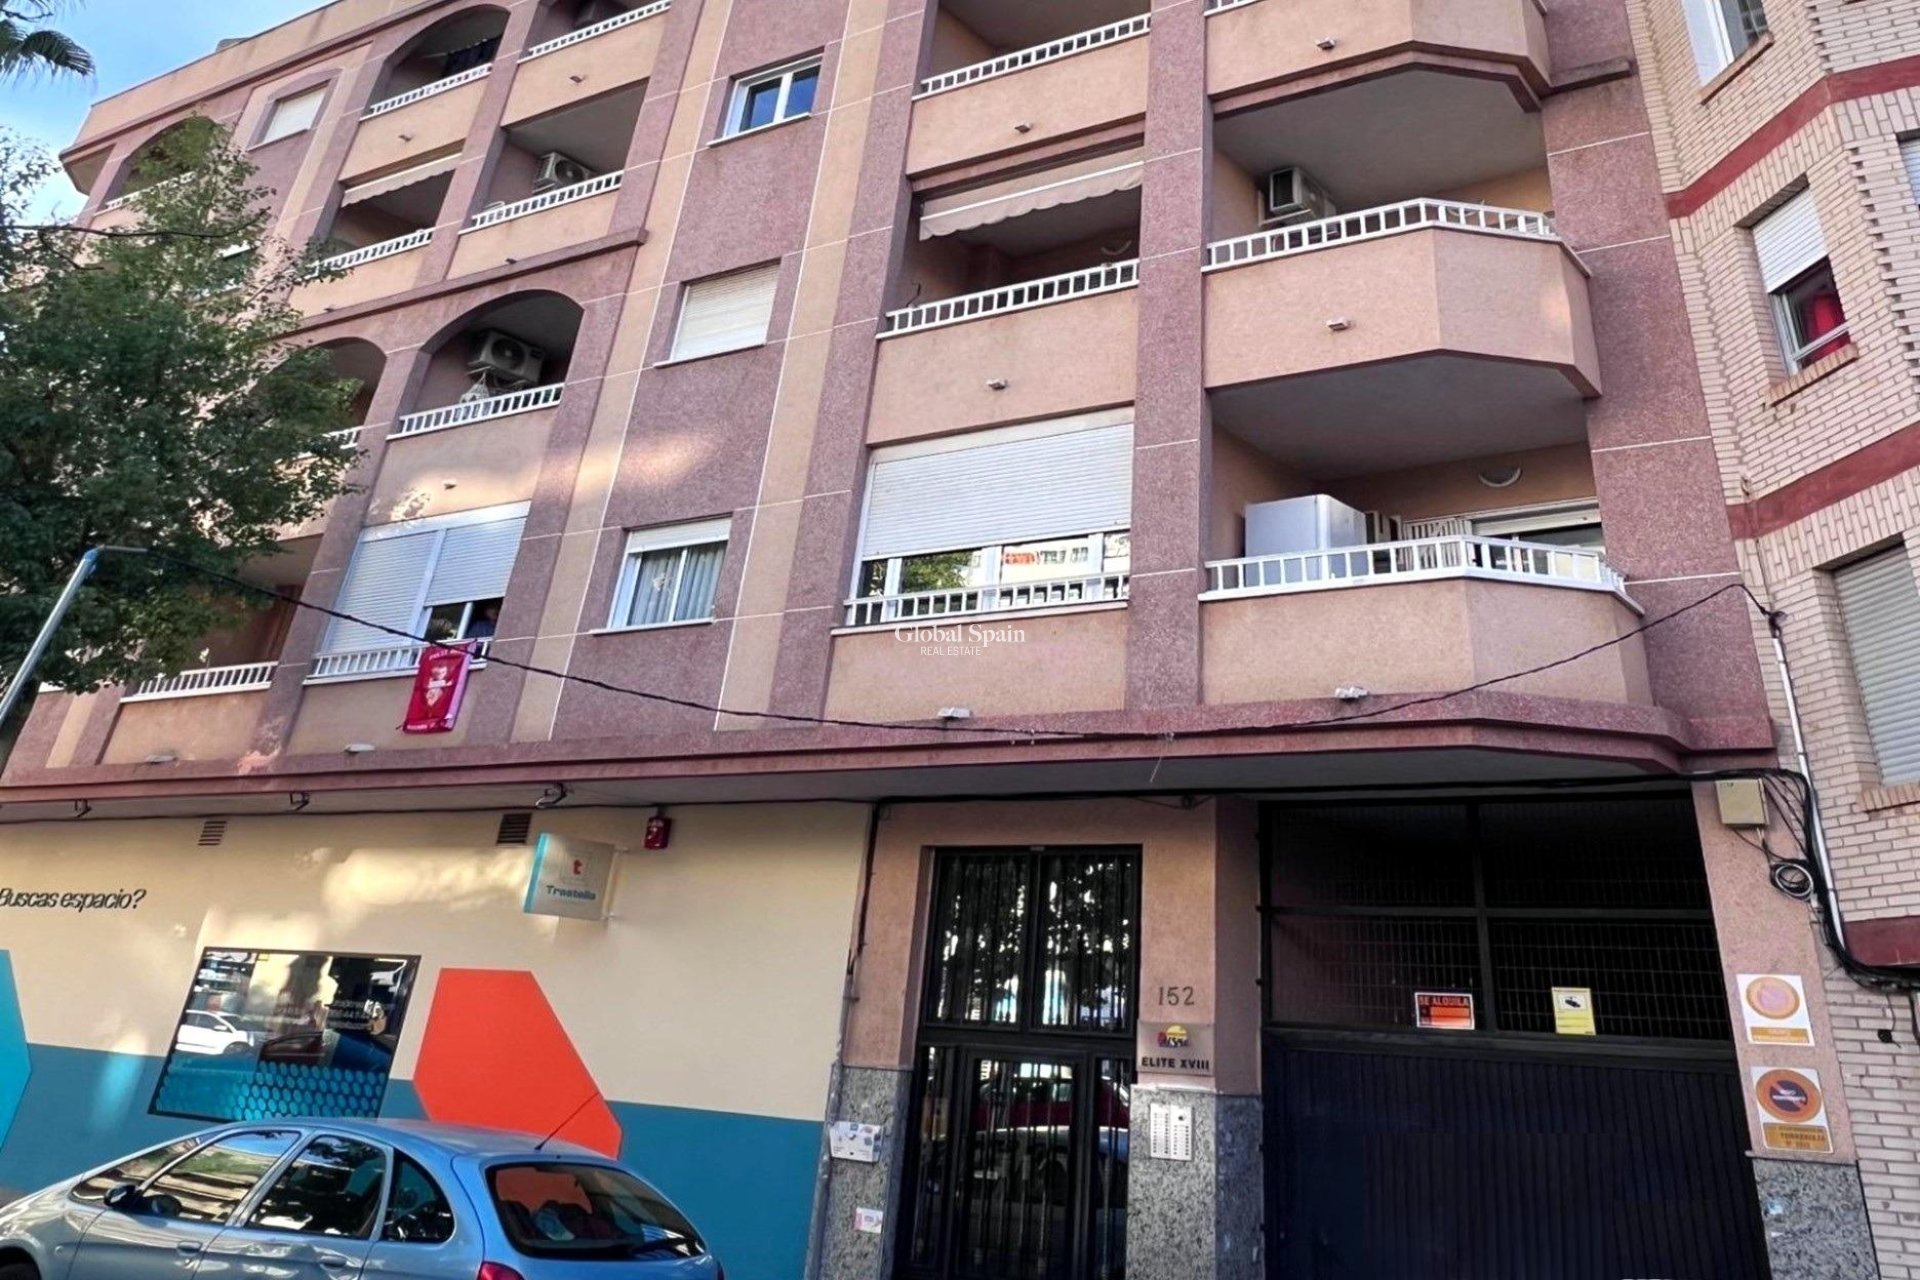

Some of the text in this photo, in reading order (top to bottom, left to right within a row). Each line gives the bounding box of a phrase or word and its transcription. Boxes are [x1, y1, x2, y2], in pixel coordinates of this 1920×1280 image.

[0, 888, 147, 912] Buscas espacio?
[1158, 986, 1195, 1006] 152
[1141, 1056, 1210, 1070] ELITE XVIII
